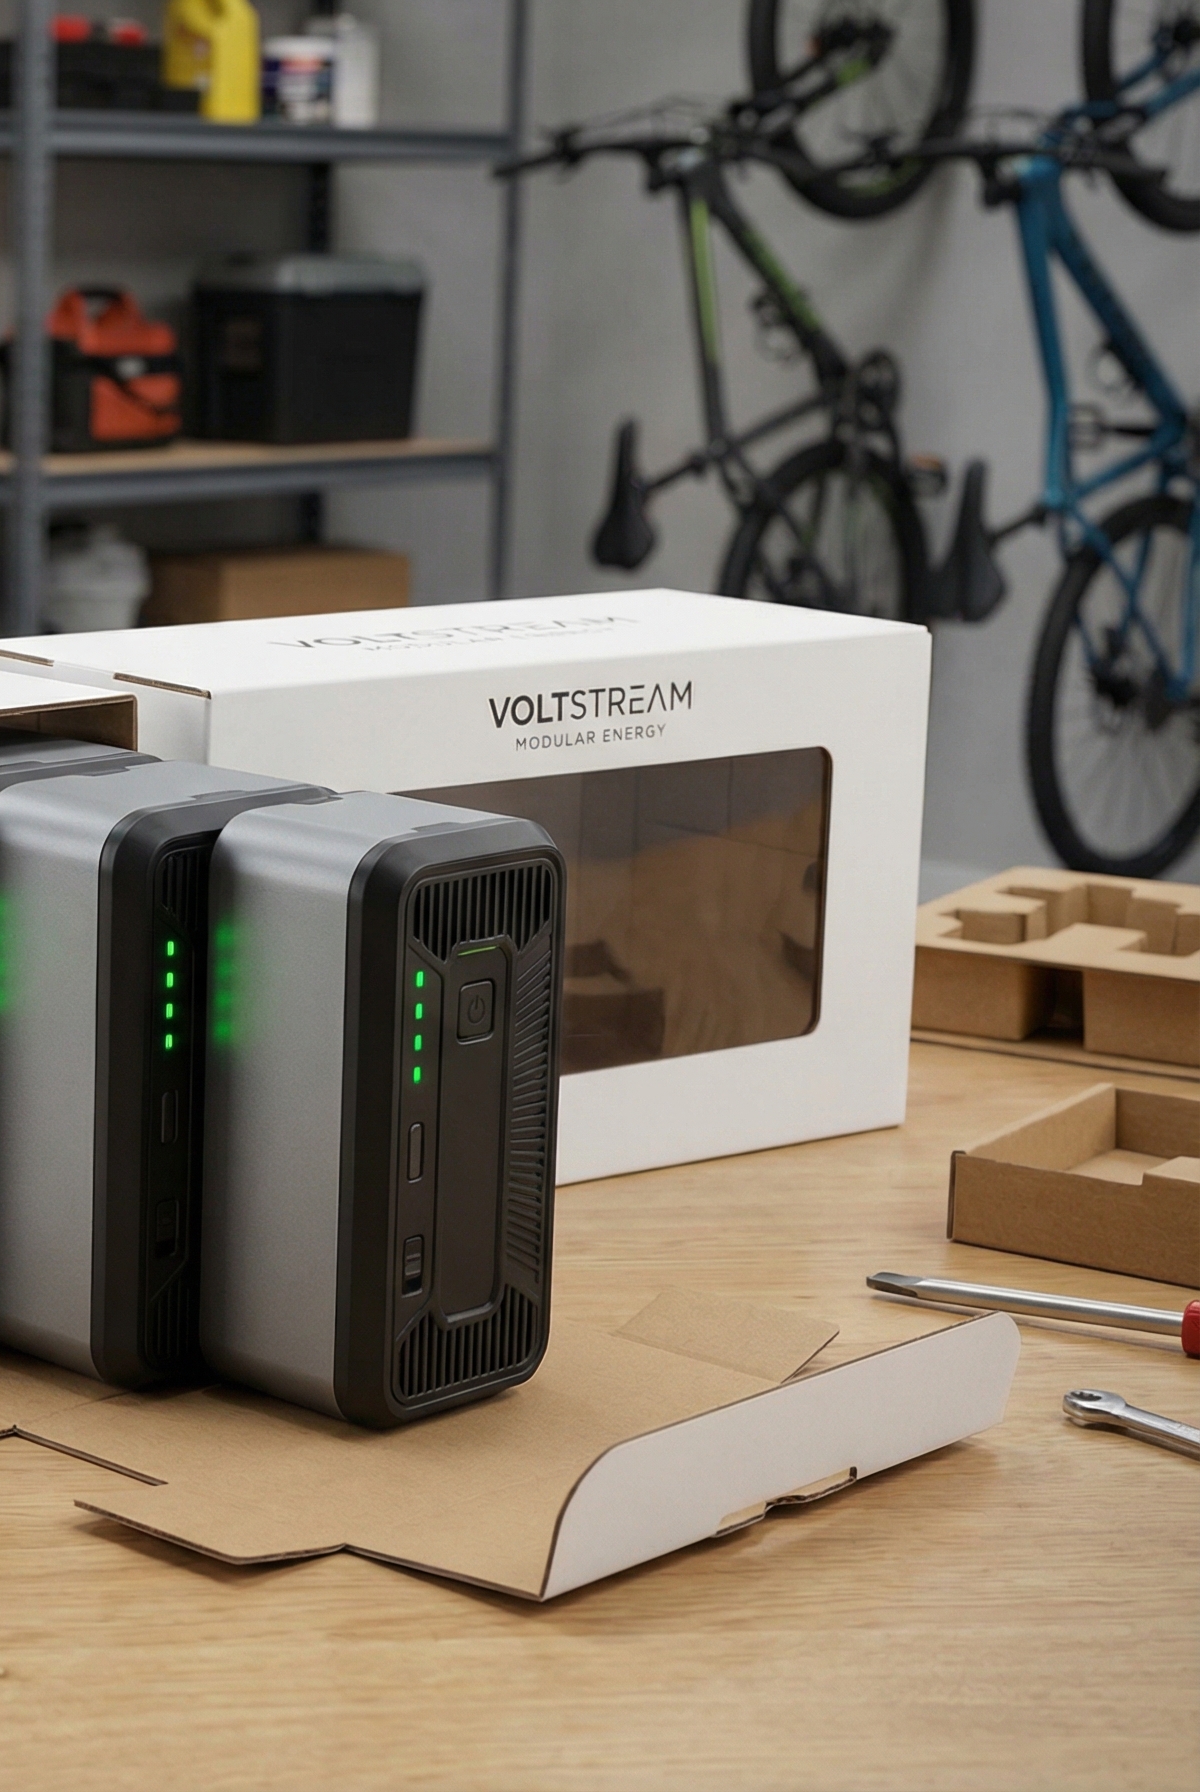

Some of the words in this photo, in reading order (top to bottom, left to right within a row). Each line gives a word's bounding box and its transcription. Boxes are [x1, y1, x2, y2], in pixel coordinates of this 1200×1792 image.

[268, 615, 640, 649] VOLTSTREAM
[488, 680, 692, 729] VOLTSTREAM
[515, 731, 596, 751] MODULAR
[602, 723, 666, 743] ENERGY
